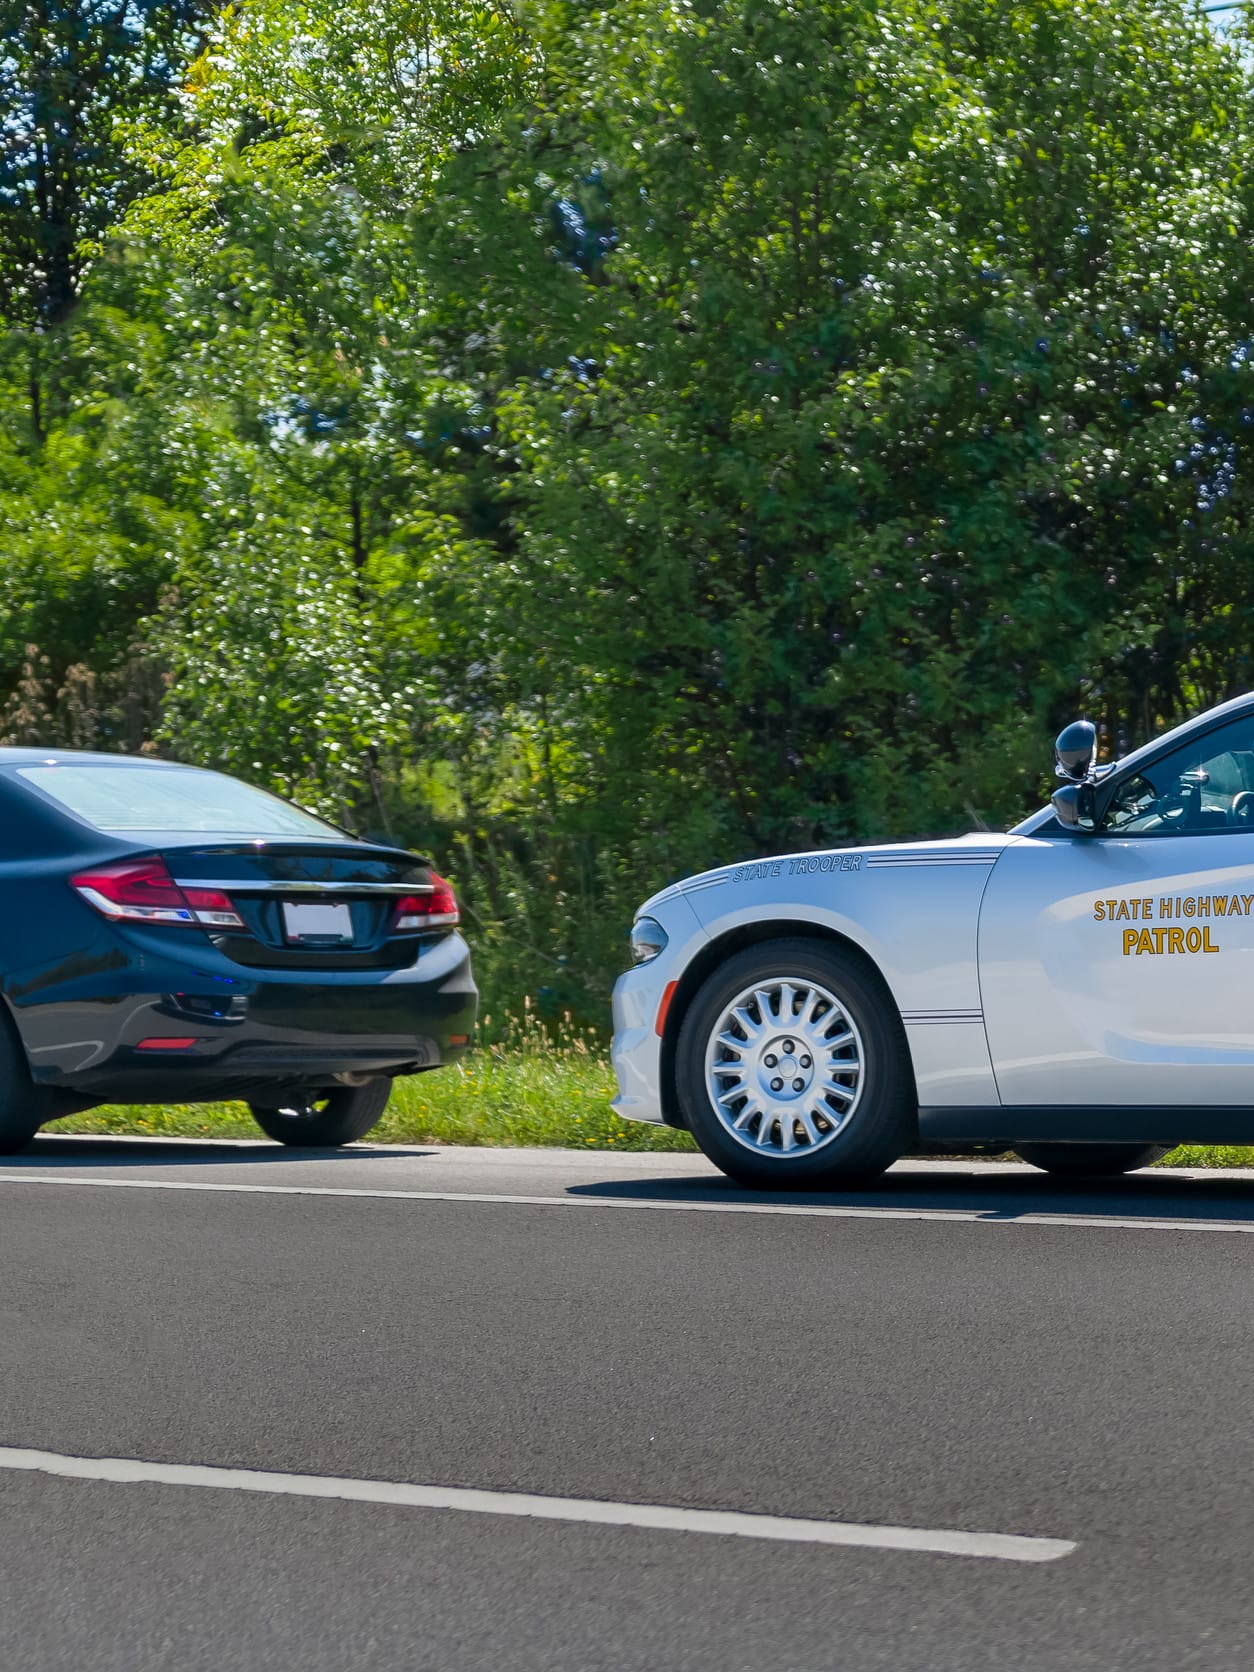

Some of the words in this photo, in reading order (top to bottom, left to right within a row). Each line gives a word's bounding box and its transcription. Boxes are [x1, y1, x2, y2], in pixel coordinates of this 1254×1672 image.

[733, 860, 784, 882] STATE
[788, 854, 862, 875] TROOPER
[1094, 898, 1153, 921] STATE
[1159, 894, 1254, 919] HIGHWAY
[1122, 925, 1219, 955] PATROL
